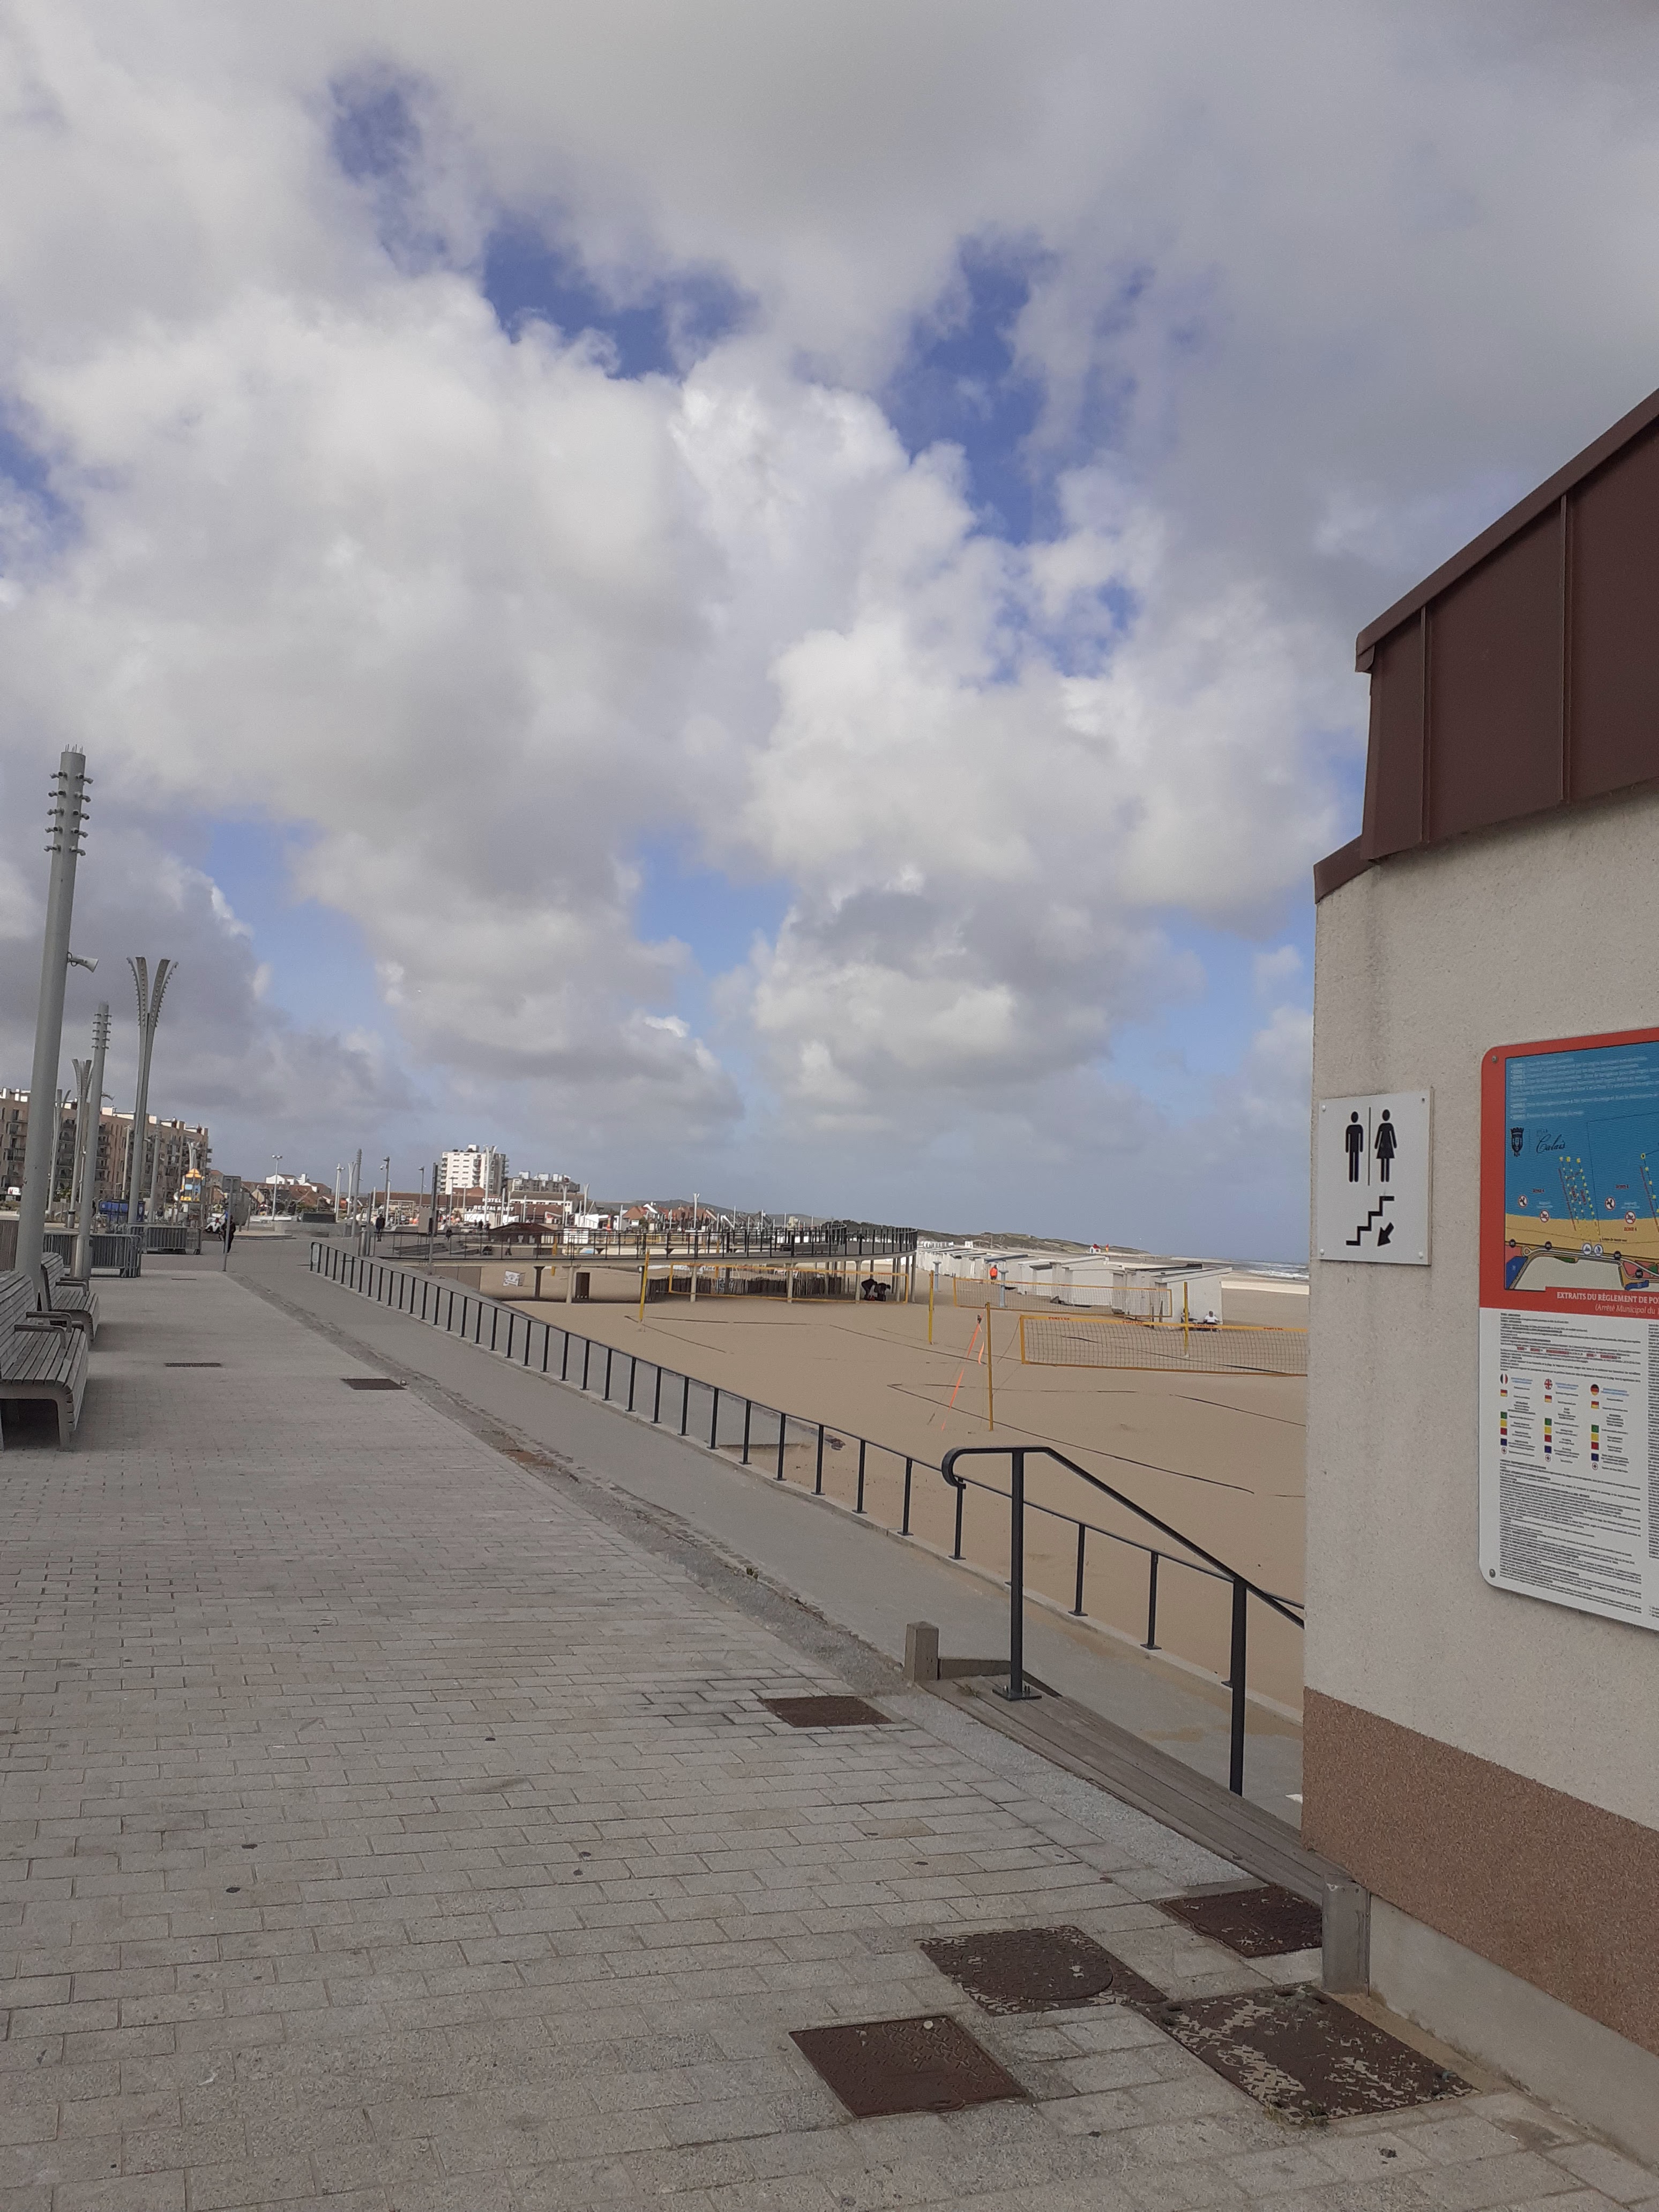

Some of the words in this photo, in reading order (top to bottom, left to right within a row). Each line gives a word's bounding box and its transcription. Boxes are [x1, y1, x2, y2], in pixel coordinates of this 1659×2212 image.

[1557, 1291, 1586, 1300] EXTRAITS
[1616, 1304, 1647, 1314] Municipal
[1647, 1306, 1655, 1314] du
